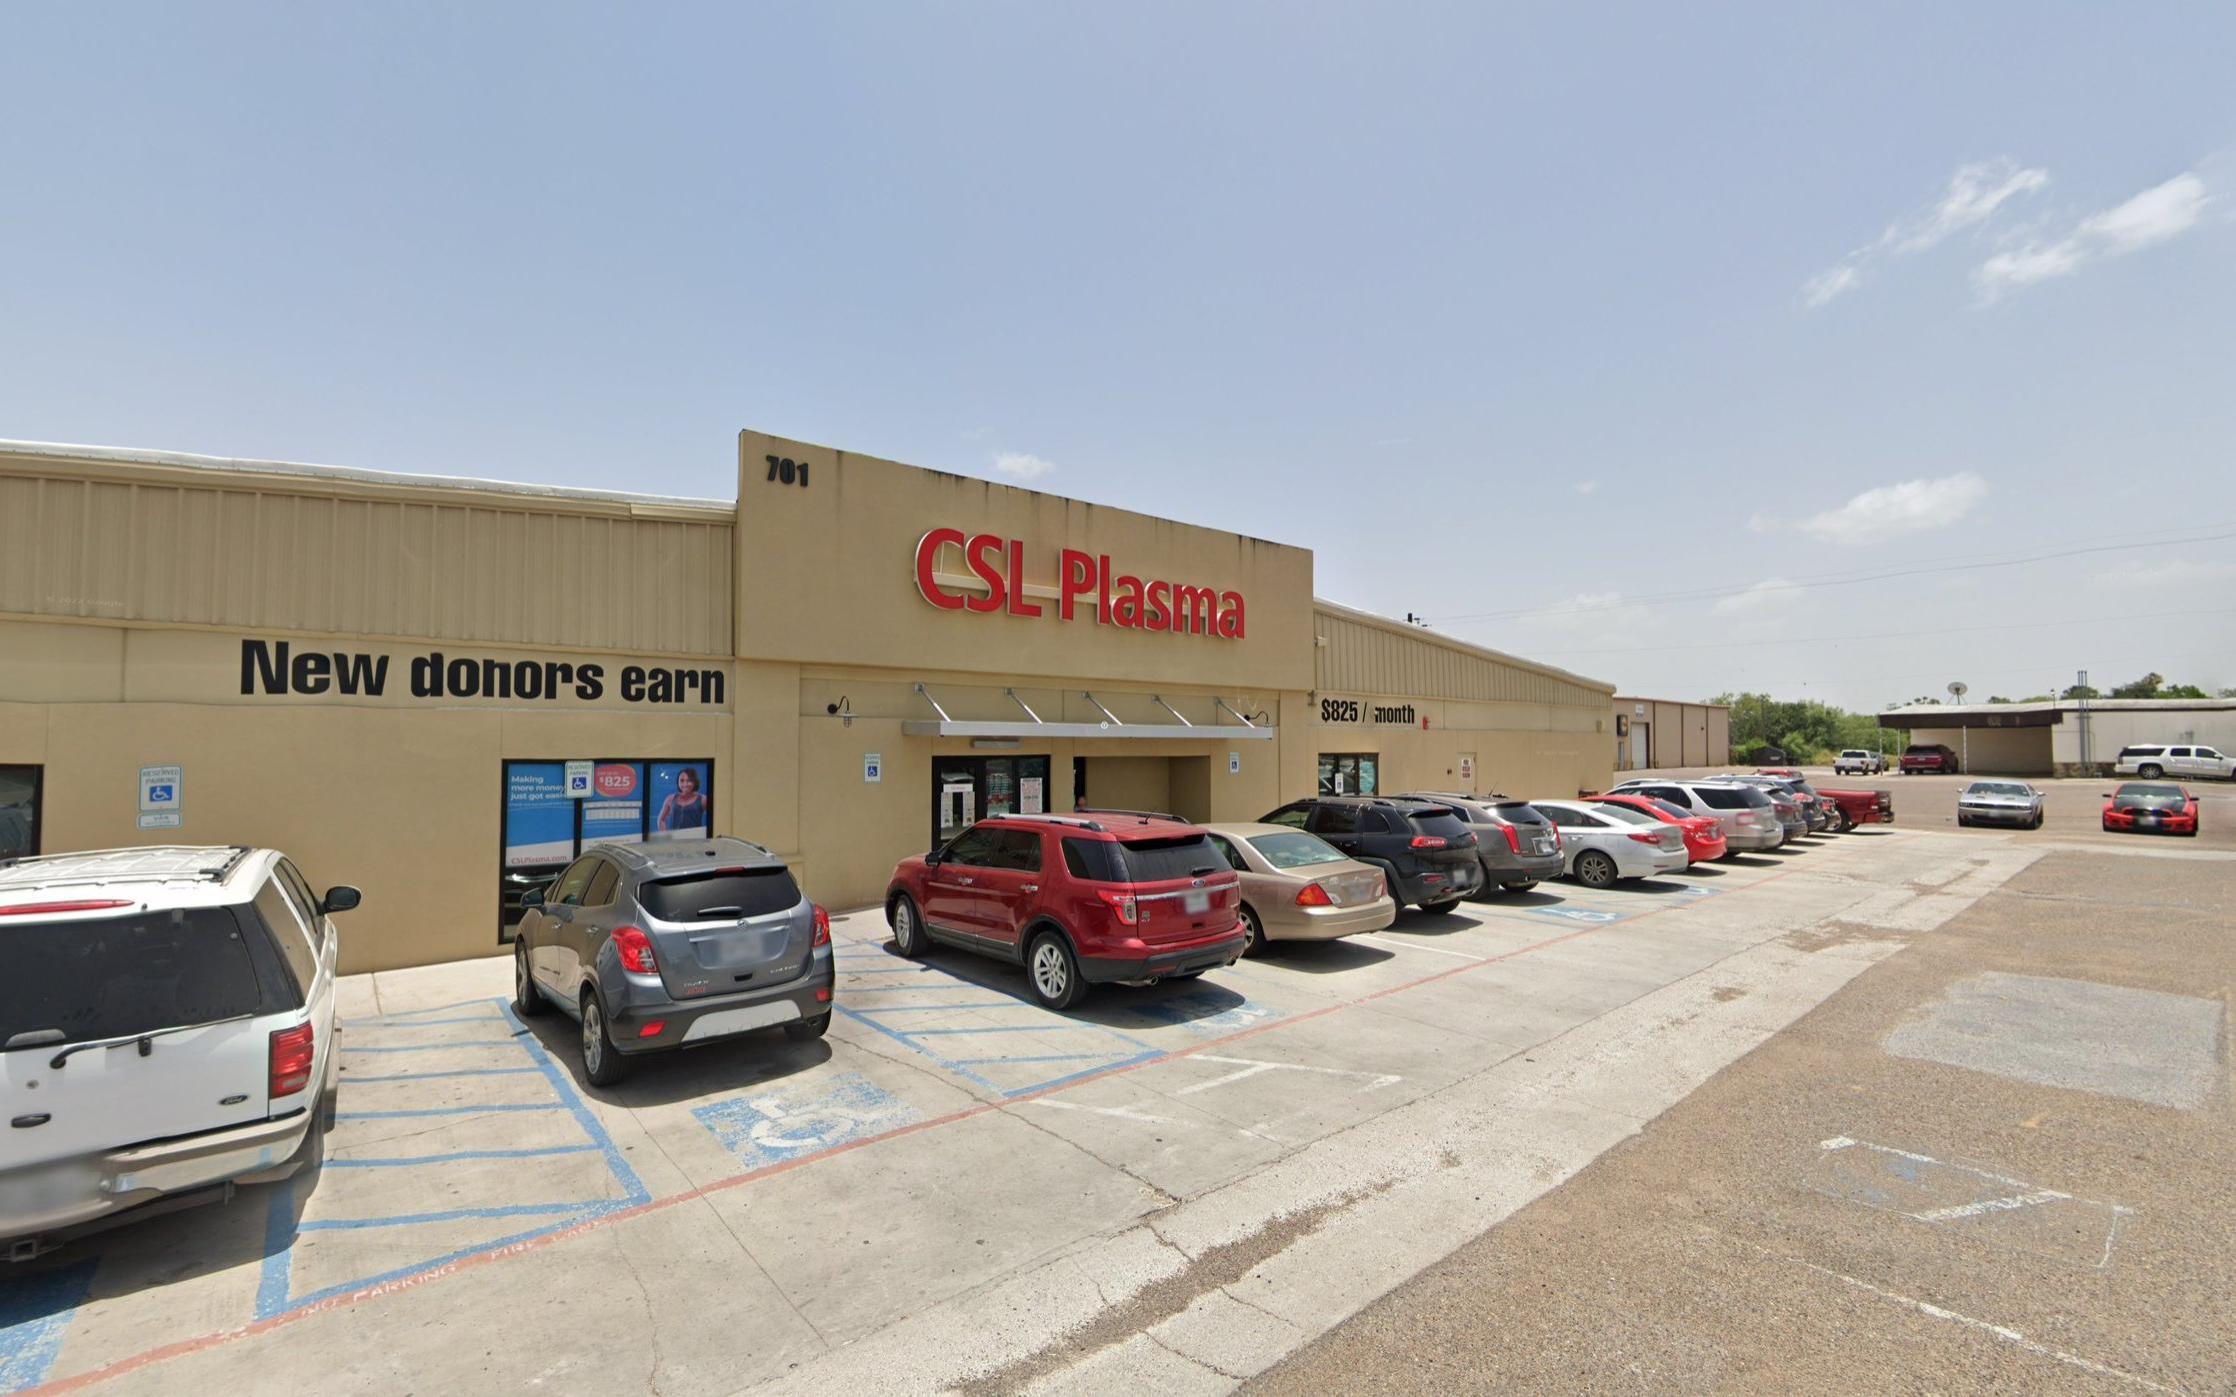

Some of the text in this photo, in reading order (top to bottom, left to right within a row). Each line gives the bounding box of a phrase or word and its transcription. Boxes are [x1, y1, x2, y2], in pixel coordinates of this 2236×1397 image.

[766, 455, 809, 488] 701
[914, 527, 1246, 640] CSL Plasma
[240, 639, 725, 704] New donors earn
[1321, 697, 1358, 723] $825
[1374, 704, 1415, 724] month
[511, 776, 544, 784] Making
[599, 776, 631, 787] $825
[536, 785, 567, 793] money
[528, 792, 544, 800] got
[511, 855, 568, 865] CSLPlasma.com
